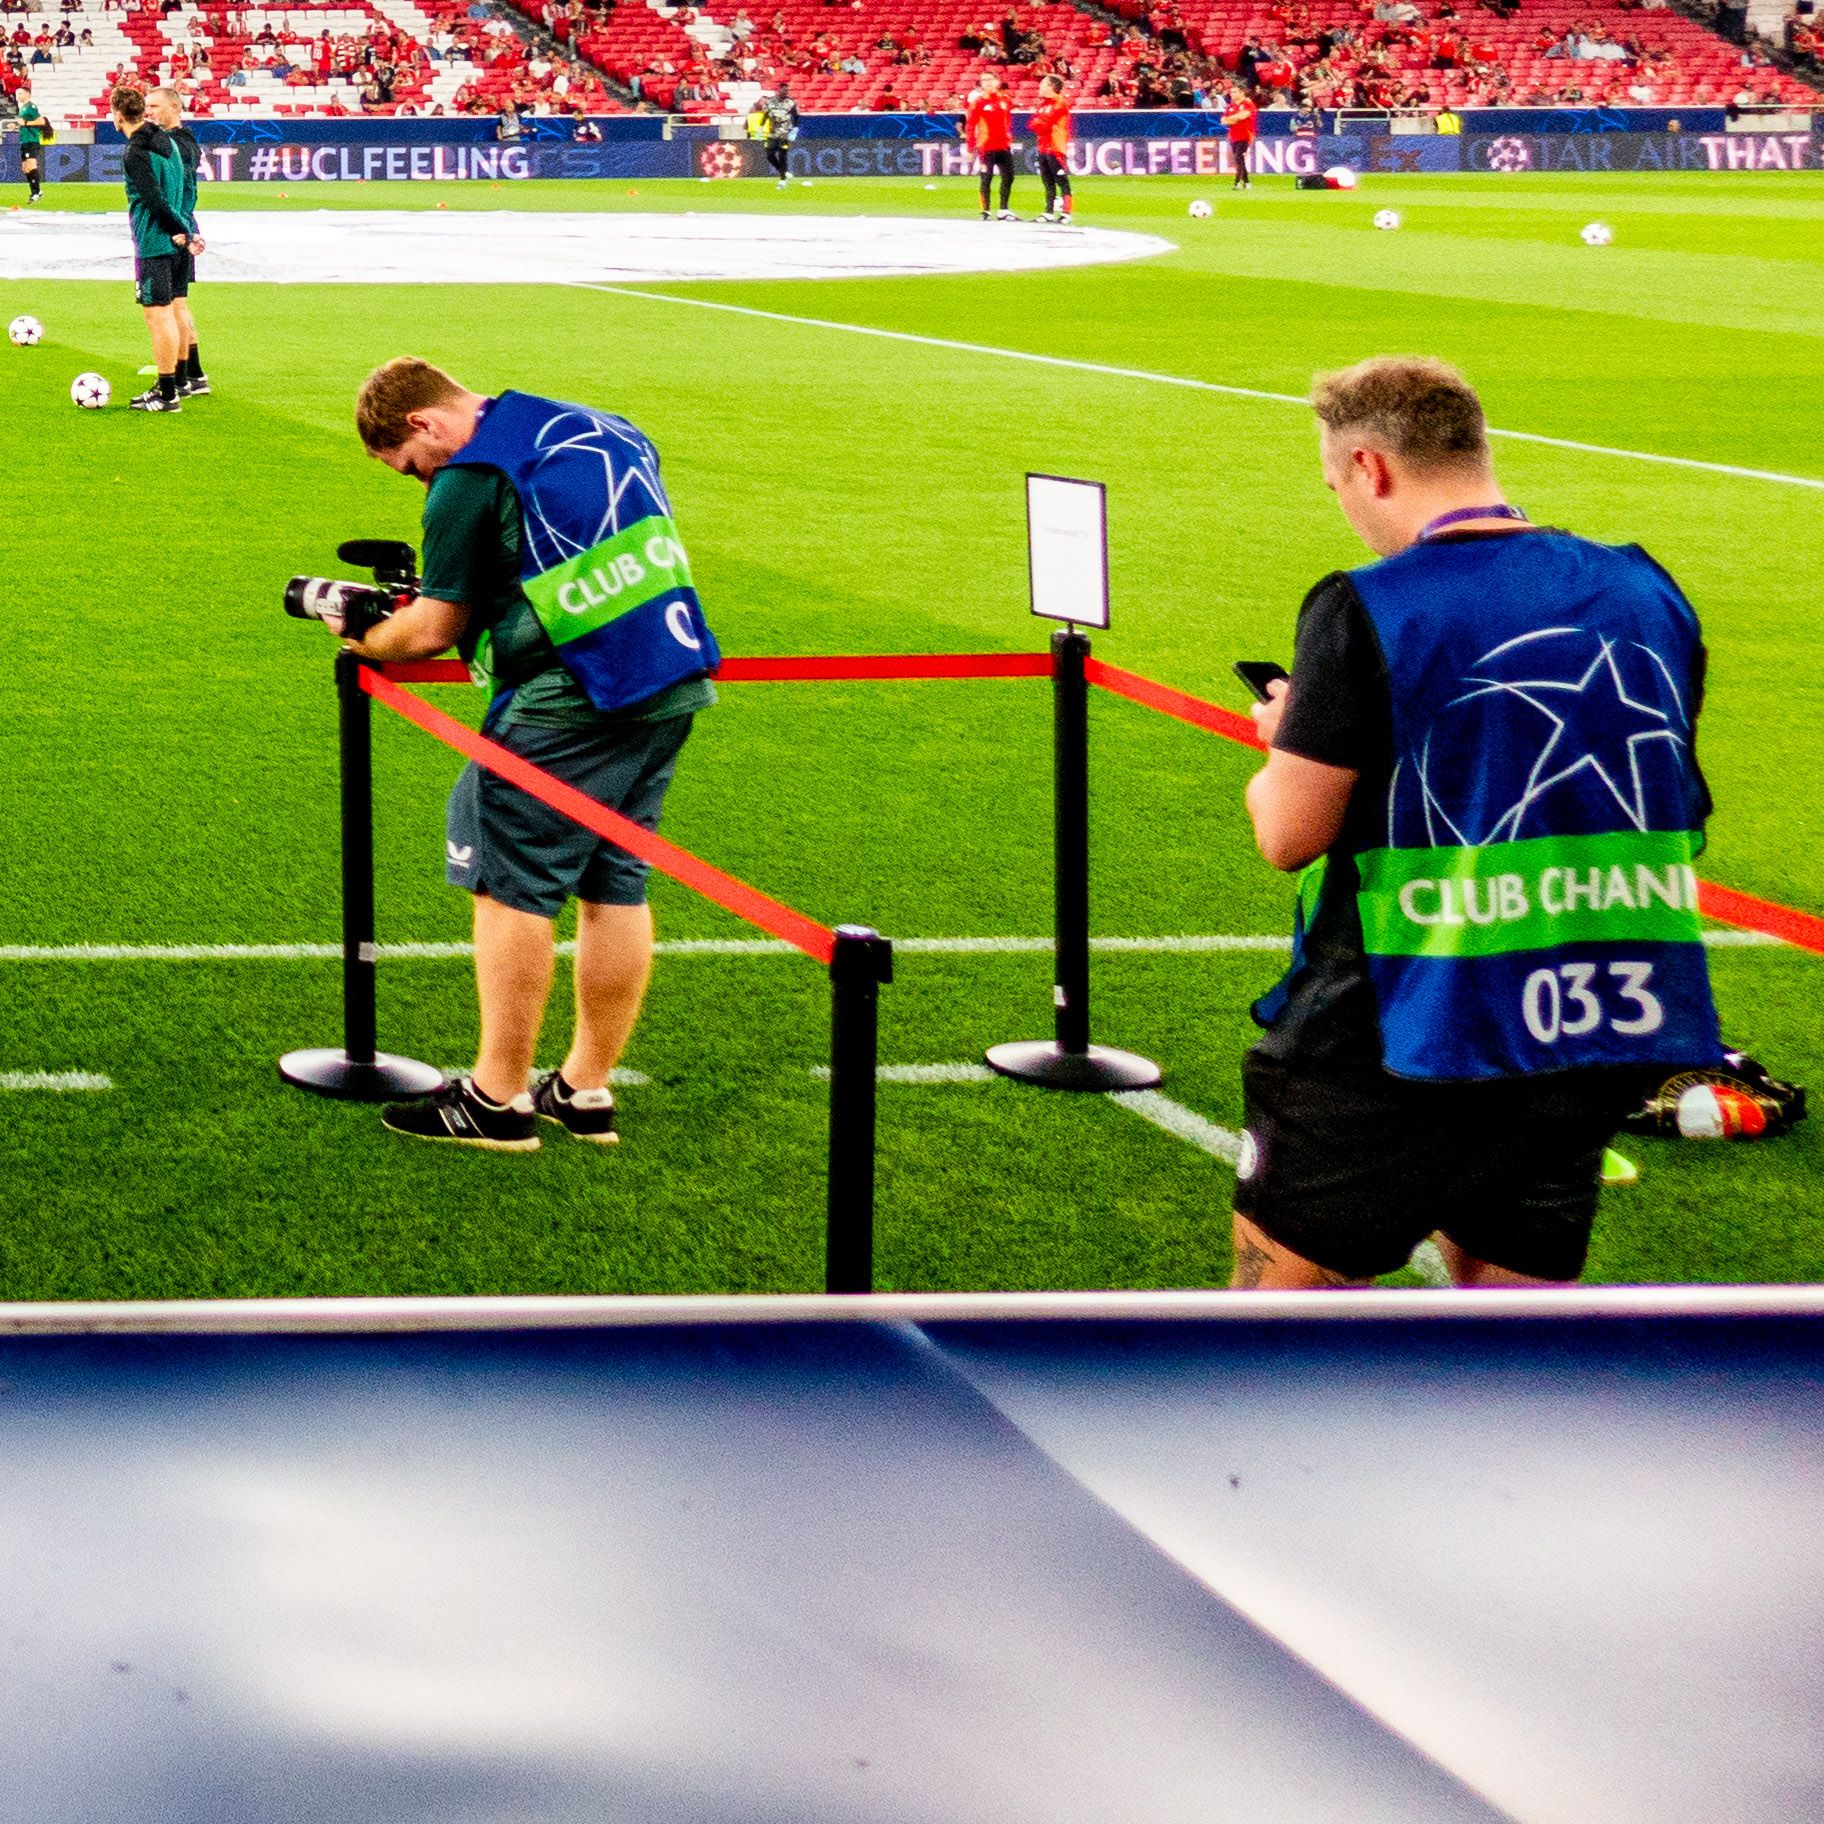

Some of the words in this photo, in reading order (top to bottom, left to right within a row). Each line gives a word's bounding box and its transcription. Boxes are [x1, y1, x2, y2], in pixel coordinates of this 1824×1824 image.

[249, 146, 530, 181] #UCLFEELING
[1698, 136, 1811, 170] THAT
[558, 553, 645, 614] CLUB
[1398, 873, 1529, 925] CLUB
[1522, 961, 1663, 1043] 033
